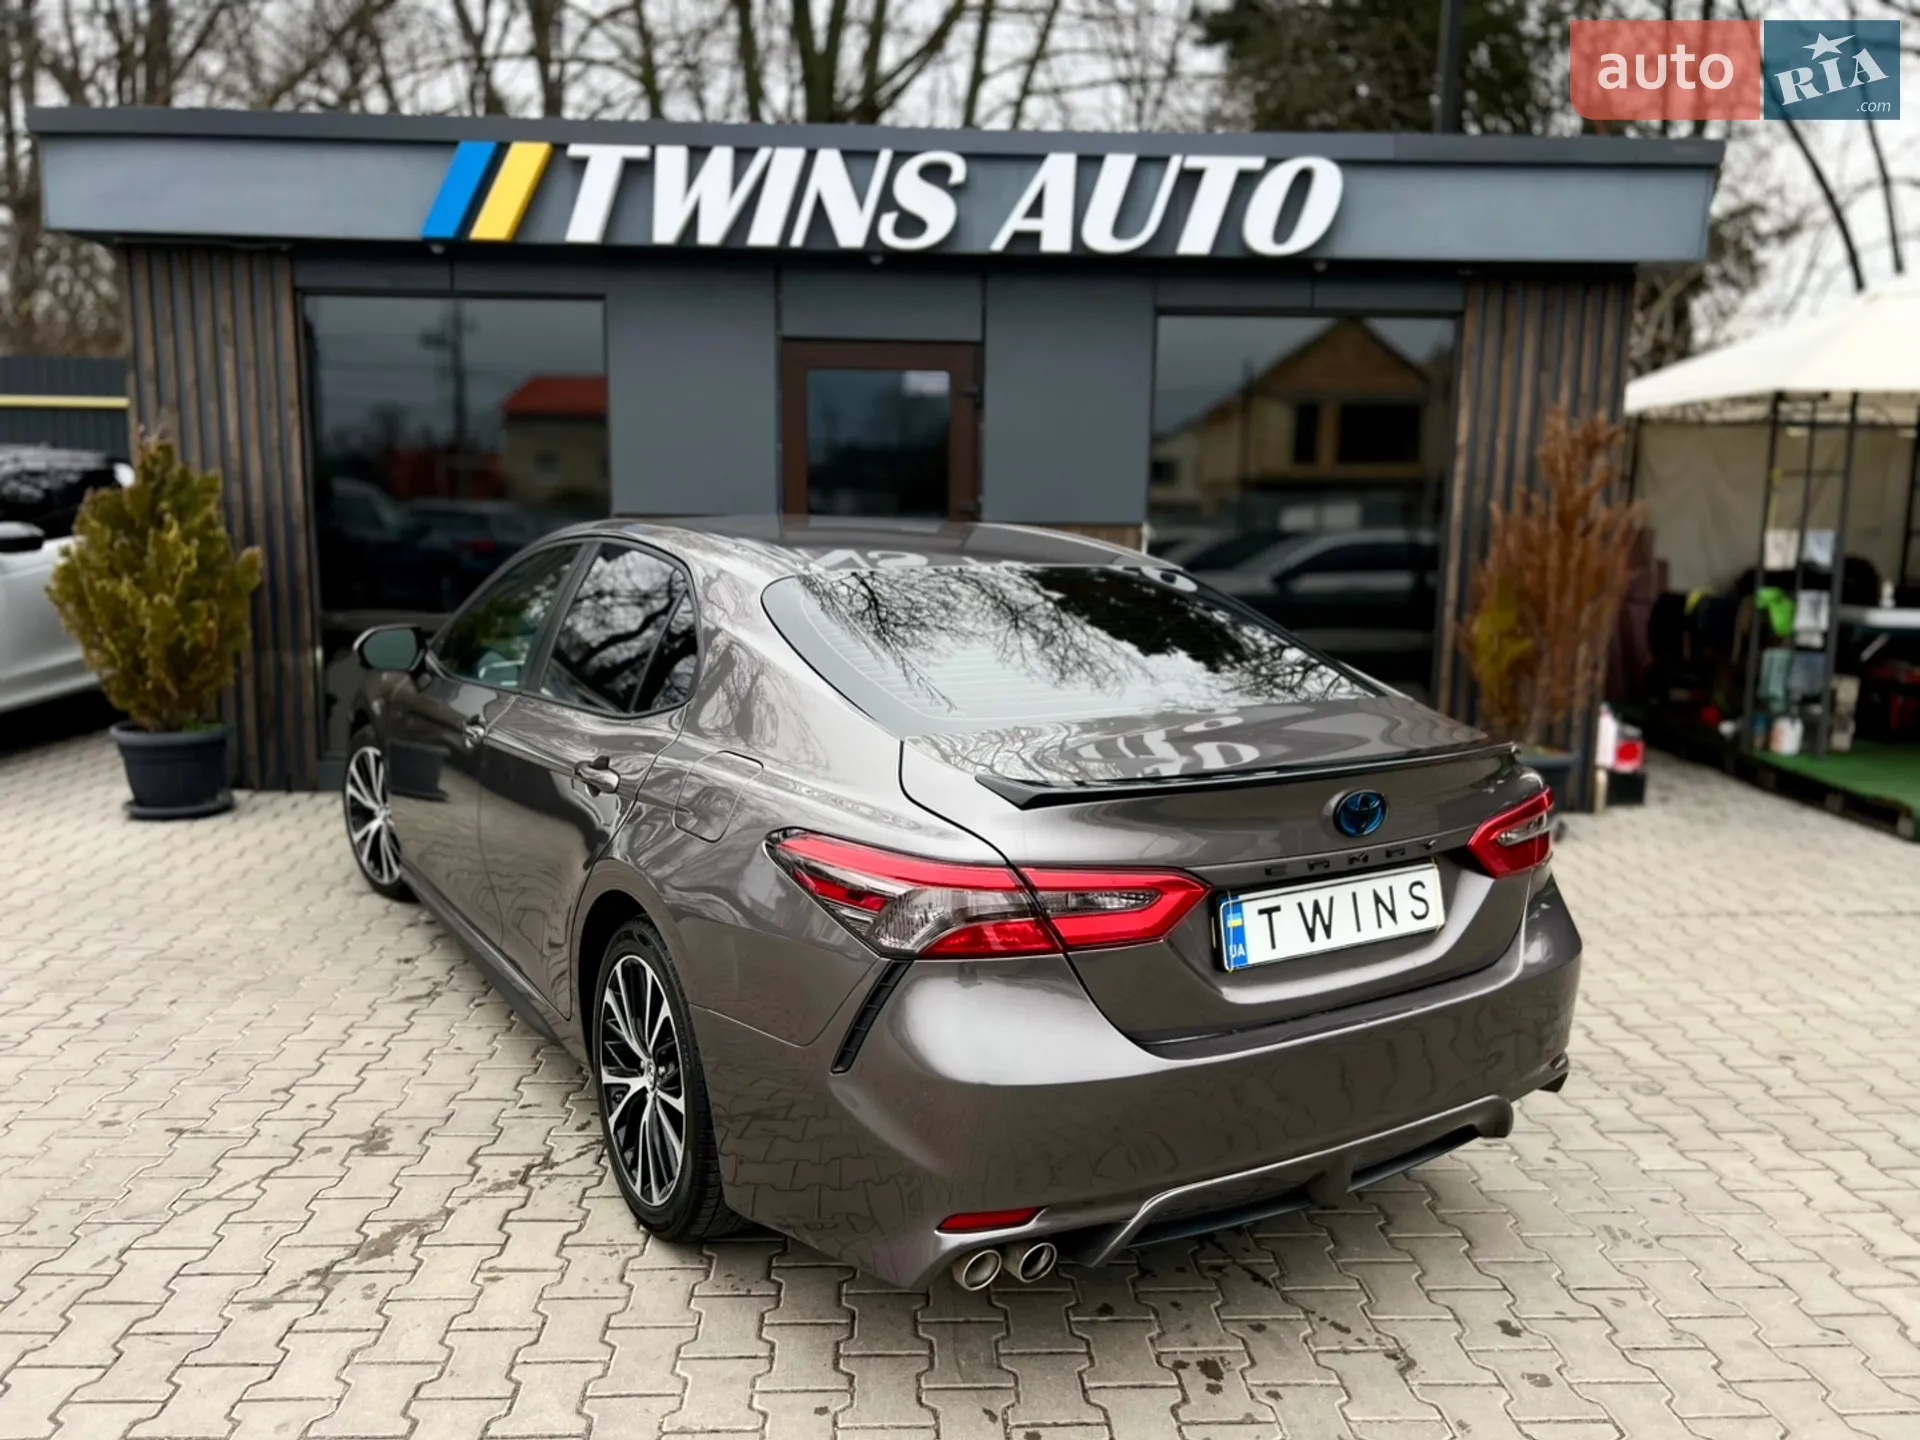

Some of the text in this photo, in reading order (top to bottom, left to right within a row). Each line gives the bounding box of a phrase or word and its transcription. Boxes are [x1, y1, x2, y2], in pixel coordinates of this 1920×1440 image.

[565, 143, 1343, 256] TWINS AUTO
[1258, 880, 1430, 950] TWINS
[1229, 943, 1246, 958] UA
